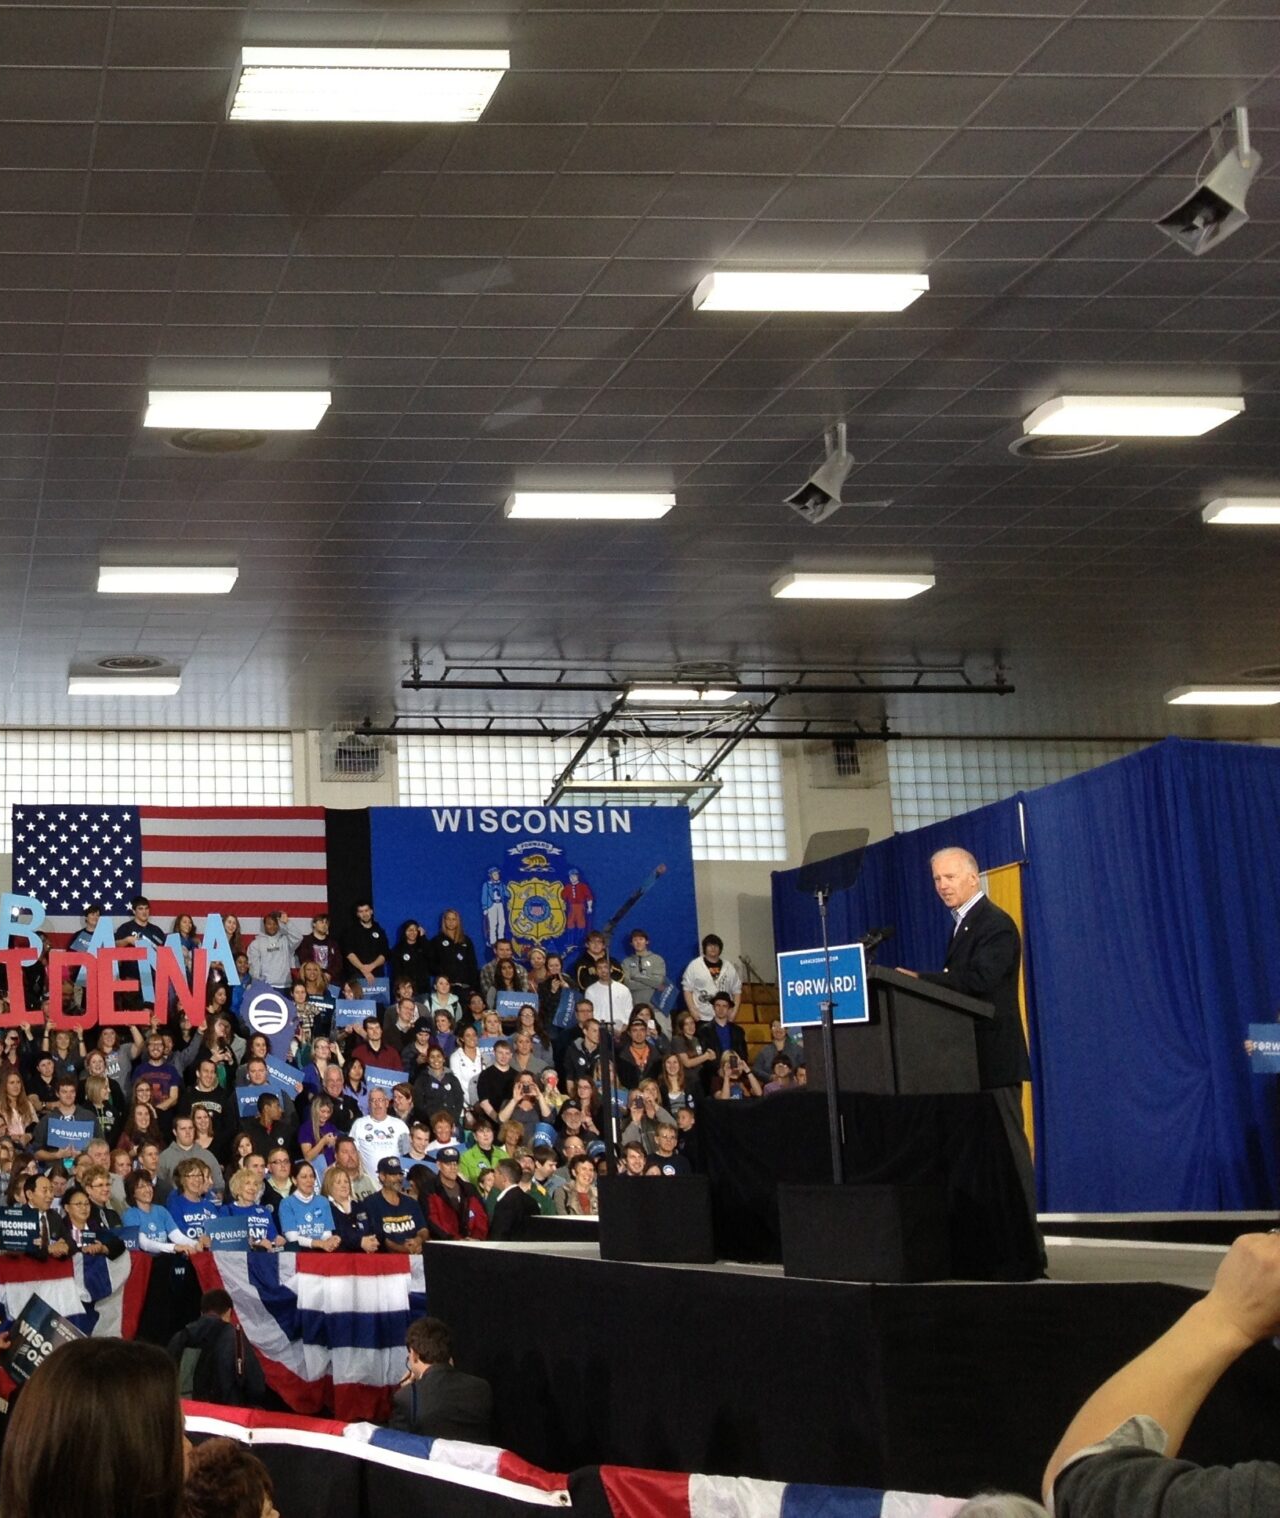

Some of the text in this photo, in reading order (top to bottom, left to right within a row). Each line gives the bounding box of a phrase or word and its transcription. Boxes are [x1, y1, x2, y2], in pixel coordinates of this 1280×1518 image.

[432, 808, 631, 834] WISCONSIN
[799, 955, 839, 966] BARACKOBAM.COM
[787, 975, 857, 997] FORWARD!
[338, 1008, 374, 1016] FORWARD!
[50, 1127, 91, 1139] FORWARD!
[209, 1229, 248, 1241] FORWARD!
